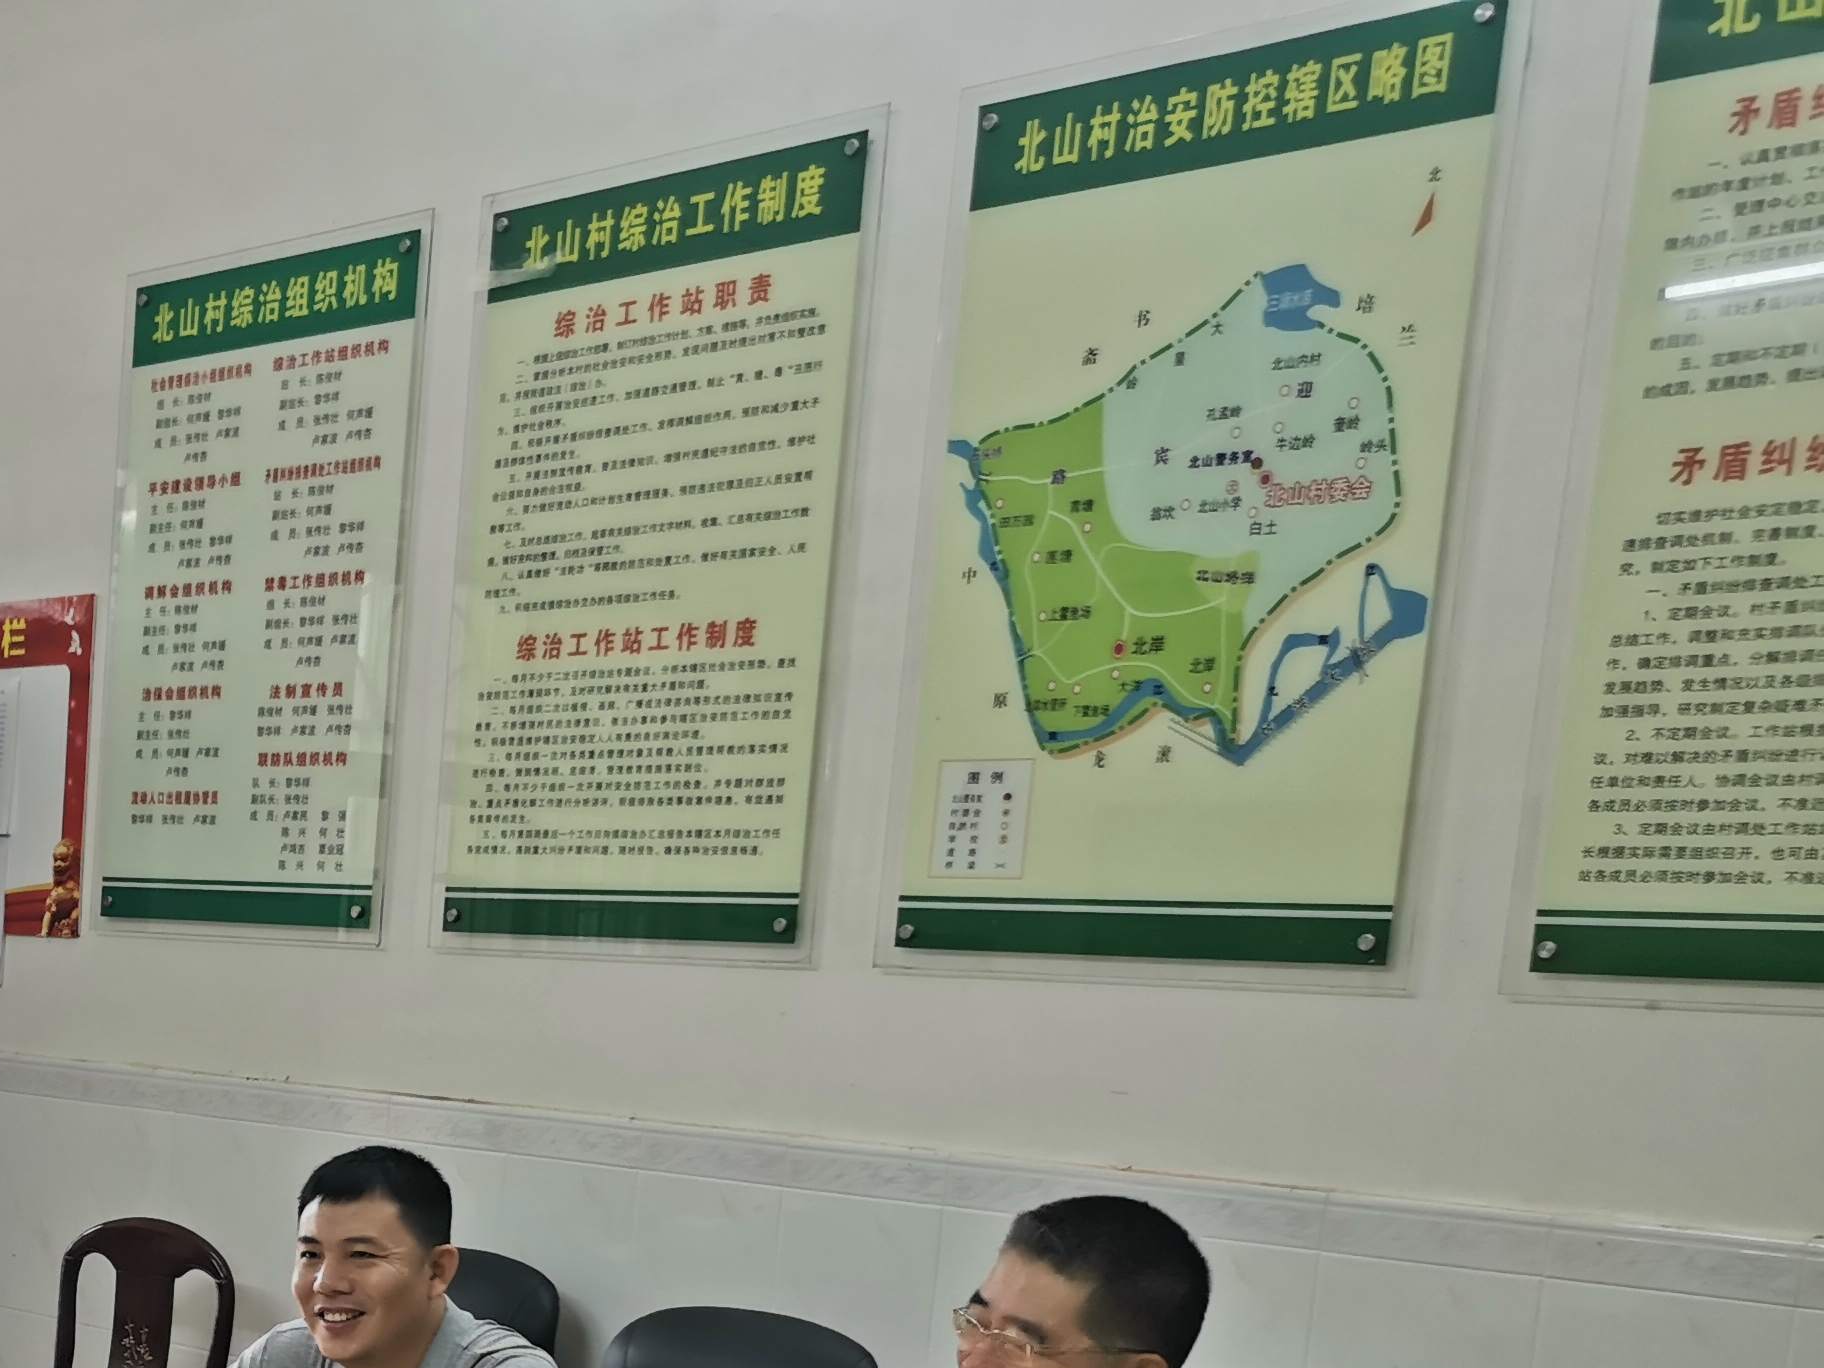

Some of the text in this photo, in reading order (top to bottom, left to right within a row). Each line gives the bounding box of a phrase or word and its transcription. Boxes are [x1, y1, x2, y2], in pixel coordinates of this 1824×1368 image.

[1013, 32, 1455, 175] 北山村治安防控辖区略图
[1428, 167, 1442, 182] 北
[523, 164, 827, 269] 北山村综治工作制度
[152, 257, 400, 343] 北山村综治组织机构
[553, 273, 773, 340] 综治工作站职责
[1295, 380, 1314, 399] 迎
[1263, 474, 1373, 508] 北山村委会
[515, 618, 758, 661] 综治工作站工作制度
[1131, 635, 1166, 656] 北岸
